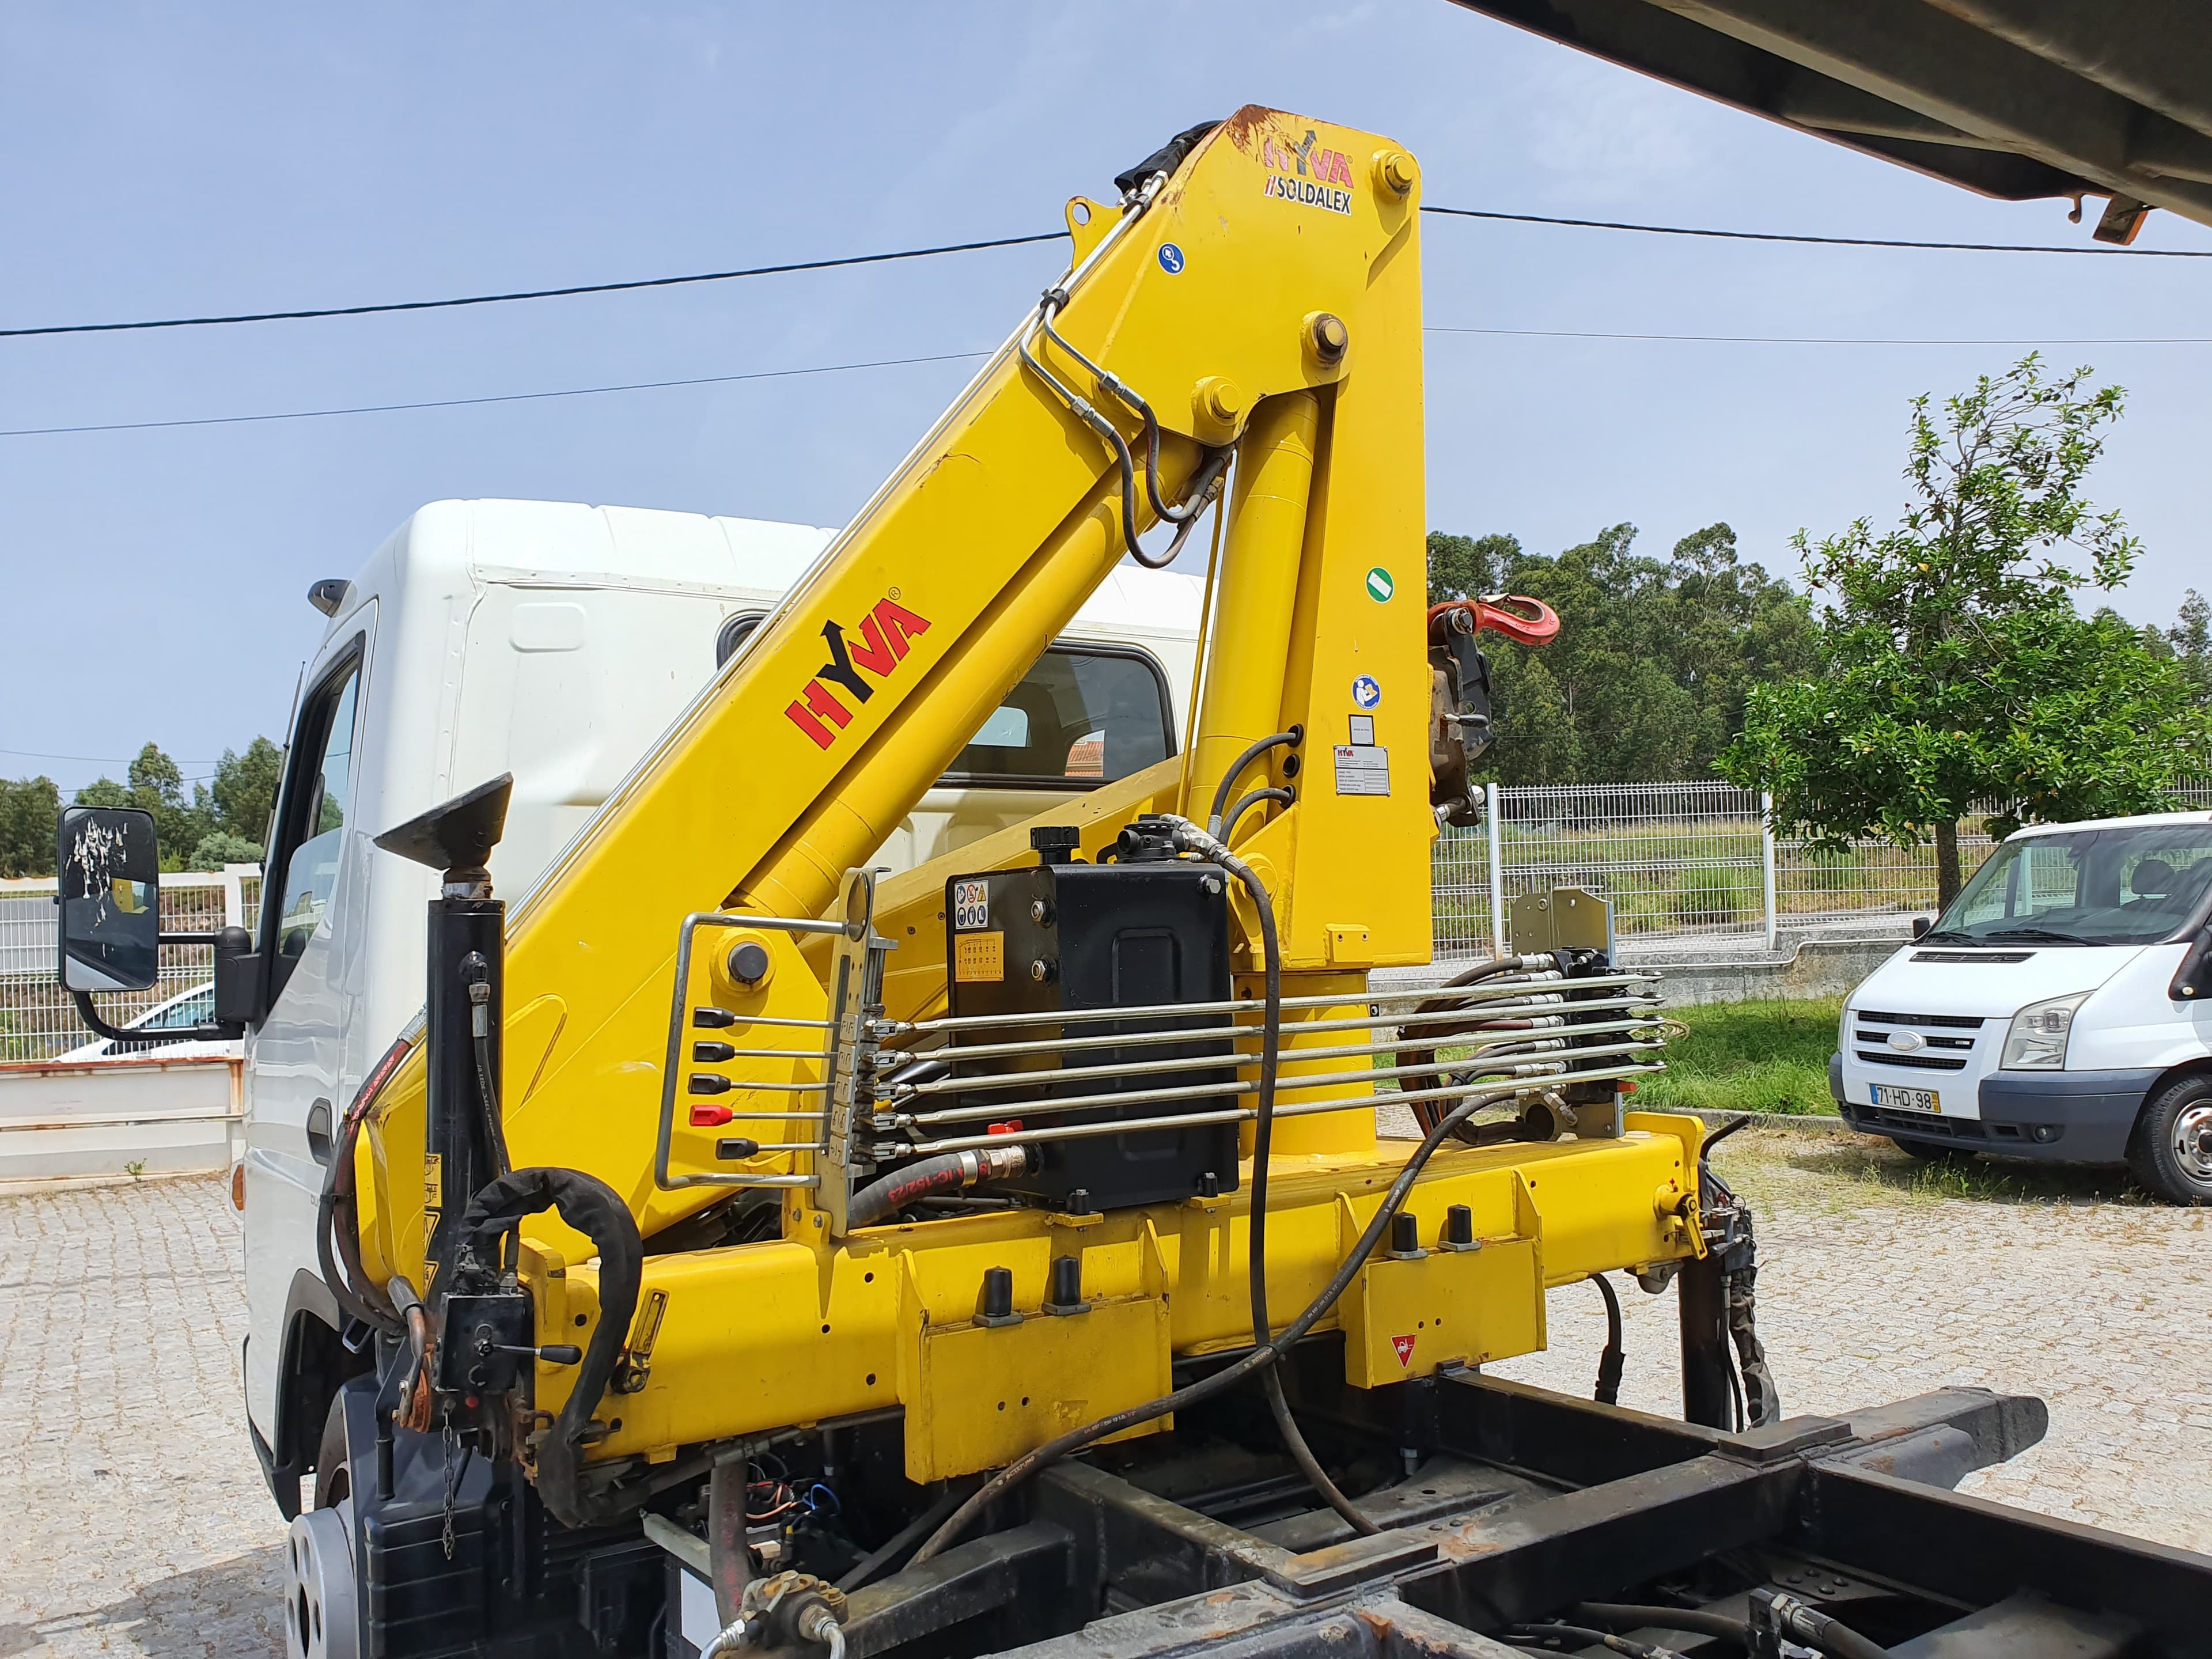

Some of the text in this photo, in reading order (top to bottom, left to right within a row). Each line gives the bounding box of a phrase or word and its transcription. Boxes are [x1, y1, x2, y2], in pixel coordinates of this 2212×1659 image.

[784, 598, 932, 751] HYVA
[1338, 747, 1353, 756] HYVA
[1006, 1456, 1035, 1479] INTERPUMP
